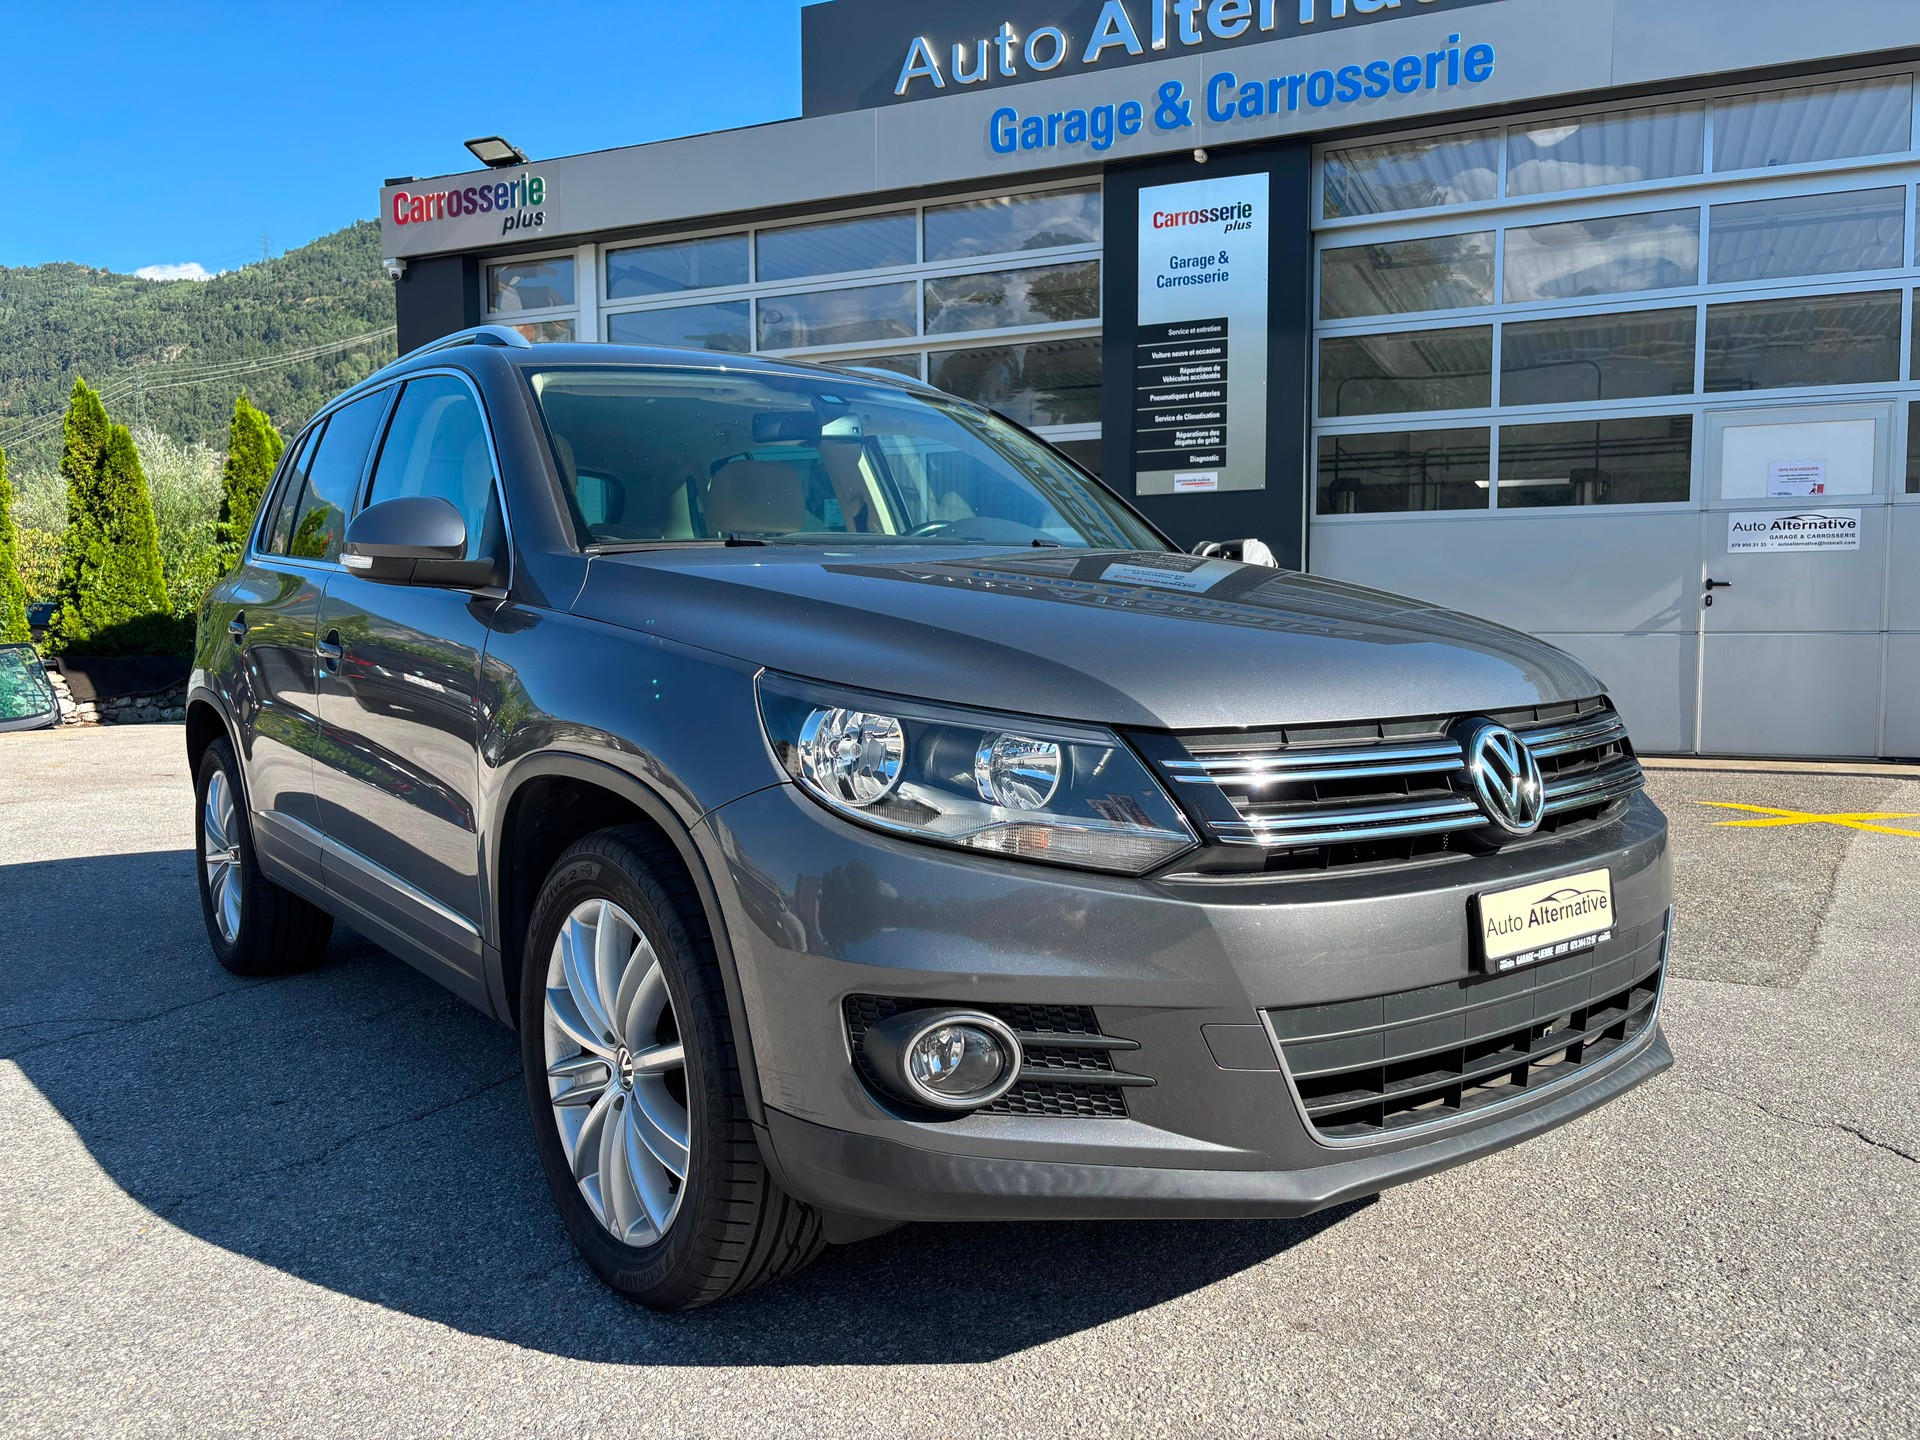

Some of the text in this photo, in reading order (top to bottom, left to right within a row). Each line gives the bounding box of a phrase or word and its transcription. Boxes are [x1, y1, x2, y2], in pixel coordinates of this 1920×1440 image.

[893, 21, 1067, 95] Auto
[989, 33, 1496, 153] Garage & Carrosserie
[393, 172, 546, 226] Carrosserie
[1153, 201, 1253, 229] Carrosserie
[502, 208, 546, 236] plus
[1224, 220, 1253, 234] plus
[1170, 250, 1229, 270] Garage &
[1156, 269, 1229, 288] Carrosserie
[1168, 327, 1189, 336] Service
[1196, 325, 1221, 333] entretien
[1151, 351, 1171, 359] Voiture
[1195, 347, 1221, 355] occasion
[1180, 365, 1212, 375] Réparations
[1162, 371, 1221, 383] Véhicules accidentés
[1149, 392, 1188, 402] Pneumatiques
[1195, 390, 1220, 398] Batteries
[1154, 411, 1220, 422] Service de Climatisation
[1176, 430, 1208, 439] Réparations
[1189, 454, 1220, 463] Diagnostic
[1732, 519, 1857, 532] Auto Alternative
[568, 869, 578, 881] 2
[1486, 895, 1608, 938] Auto Alternative
[619, 1261, 665, 1288] YOKOHAMA
